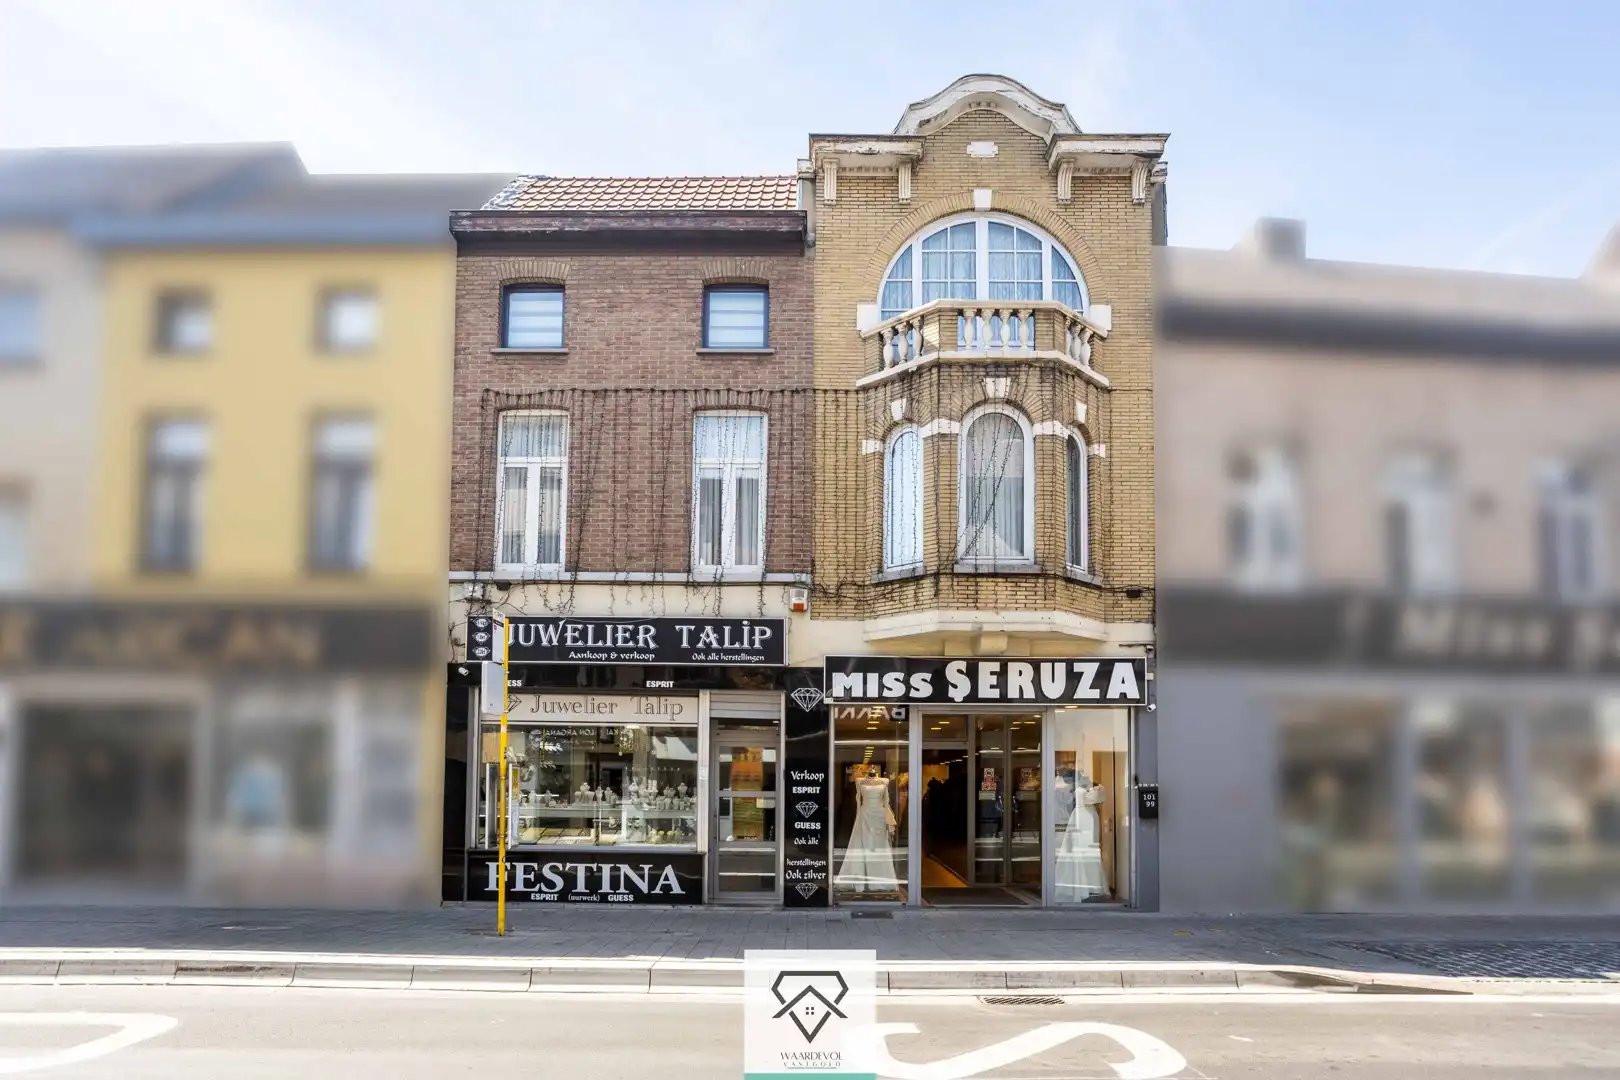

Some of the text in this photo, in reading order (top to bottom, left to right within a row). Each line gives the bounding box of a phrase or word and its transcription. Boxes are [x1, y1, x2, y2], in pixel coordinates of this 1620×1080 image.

[507, 619, 659, 650] JUWELIER
[568, 651, 655, 662] Aankoop & verkoop
[692, 652, 765, 663] Ook alle herstellingen
[507, 679, 522, 687] ESS
[646, 680, 675, 689] ESPRIT
[831, 660, 1141, 702] MISS ŞERUZA
[530, 694, 684, 721] Juwelier Talip
[790, 769, 825, 783] Verkoop
[792, 786, 821, 794] ESPRIT
[1143, 793, 1156, 801] 101
[794, 821, 822, 830] GUESS
[793, 837, 819, 845] Ook alle
[786, 858, 827, 868] herstellingen
[484, 861, 686, 894] FESTINA
[785, 869, 827, 880] Ook zilver
[531, 893, 559, 901] ESPRIT
[607, 894, 635, 902] GUESS
